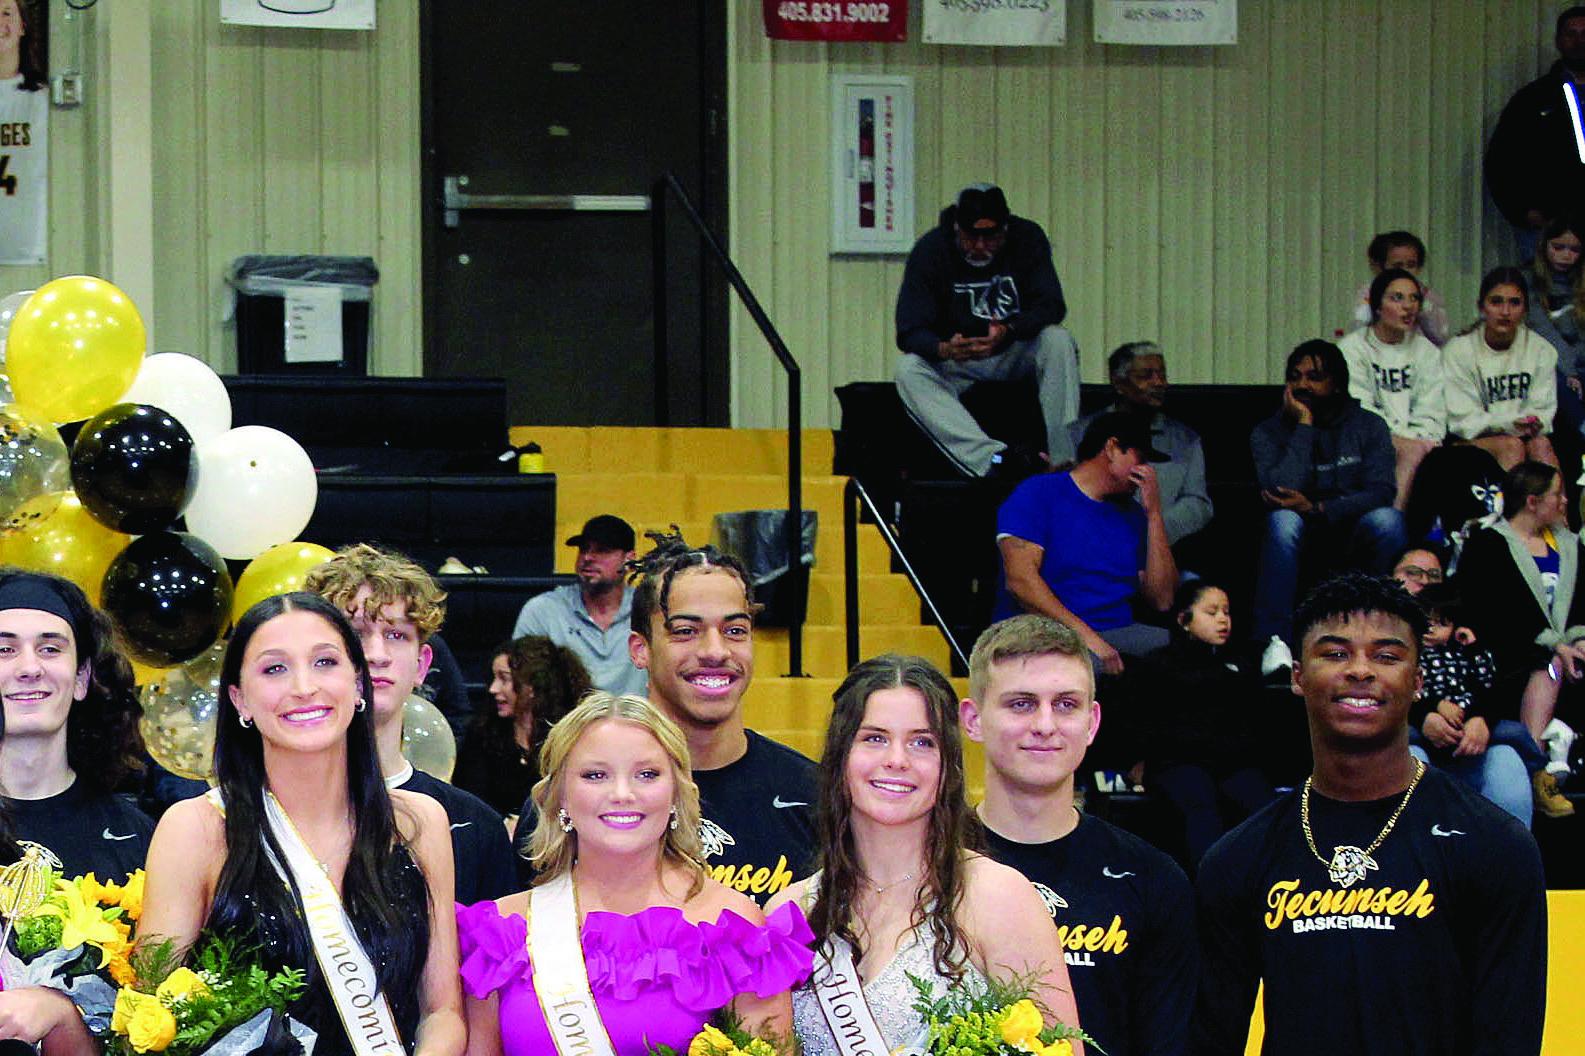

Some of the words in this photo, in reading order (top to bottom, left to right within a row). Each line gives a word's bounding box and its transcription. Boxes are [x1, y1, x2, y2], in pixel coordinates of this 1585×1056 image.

[778, 1, 890, 22] 405.831.9002
[1264, 878, 1436, 930] Tecumseh
[1292, 914, 1397, 934] BASKETBALL
